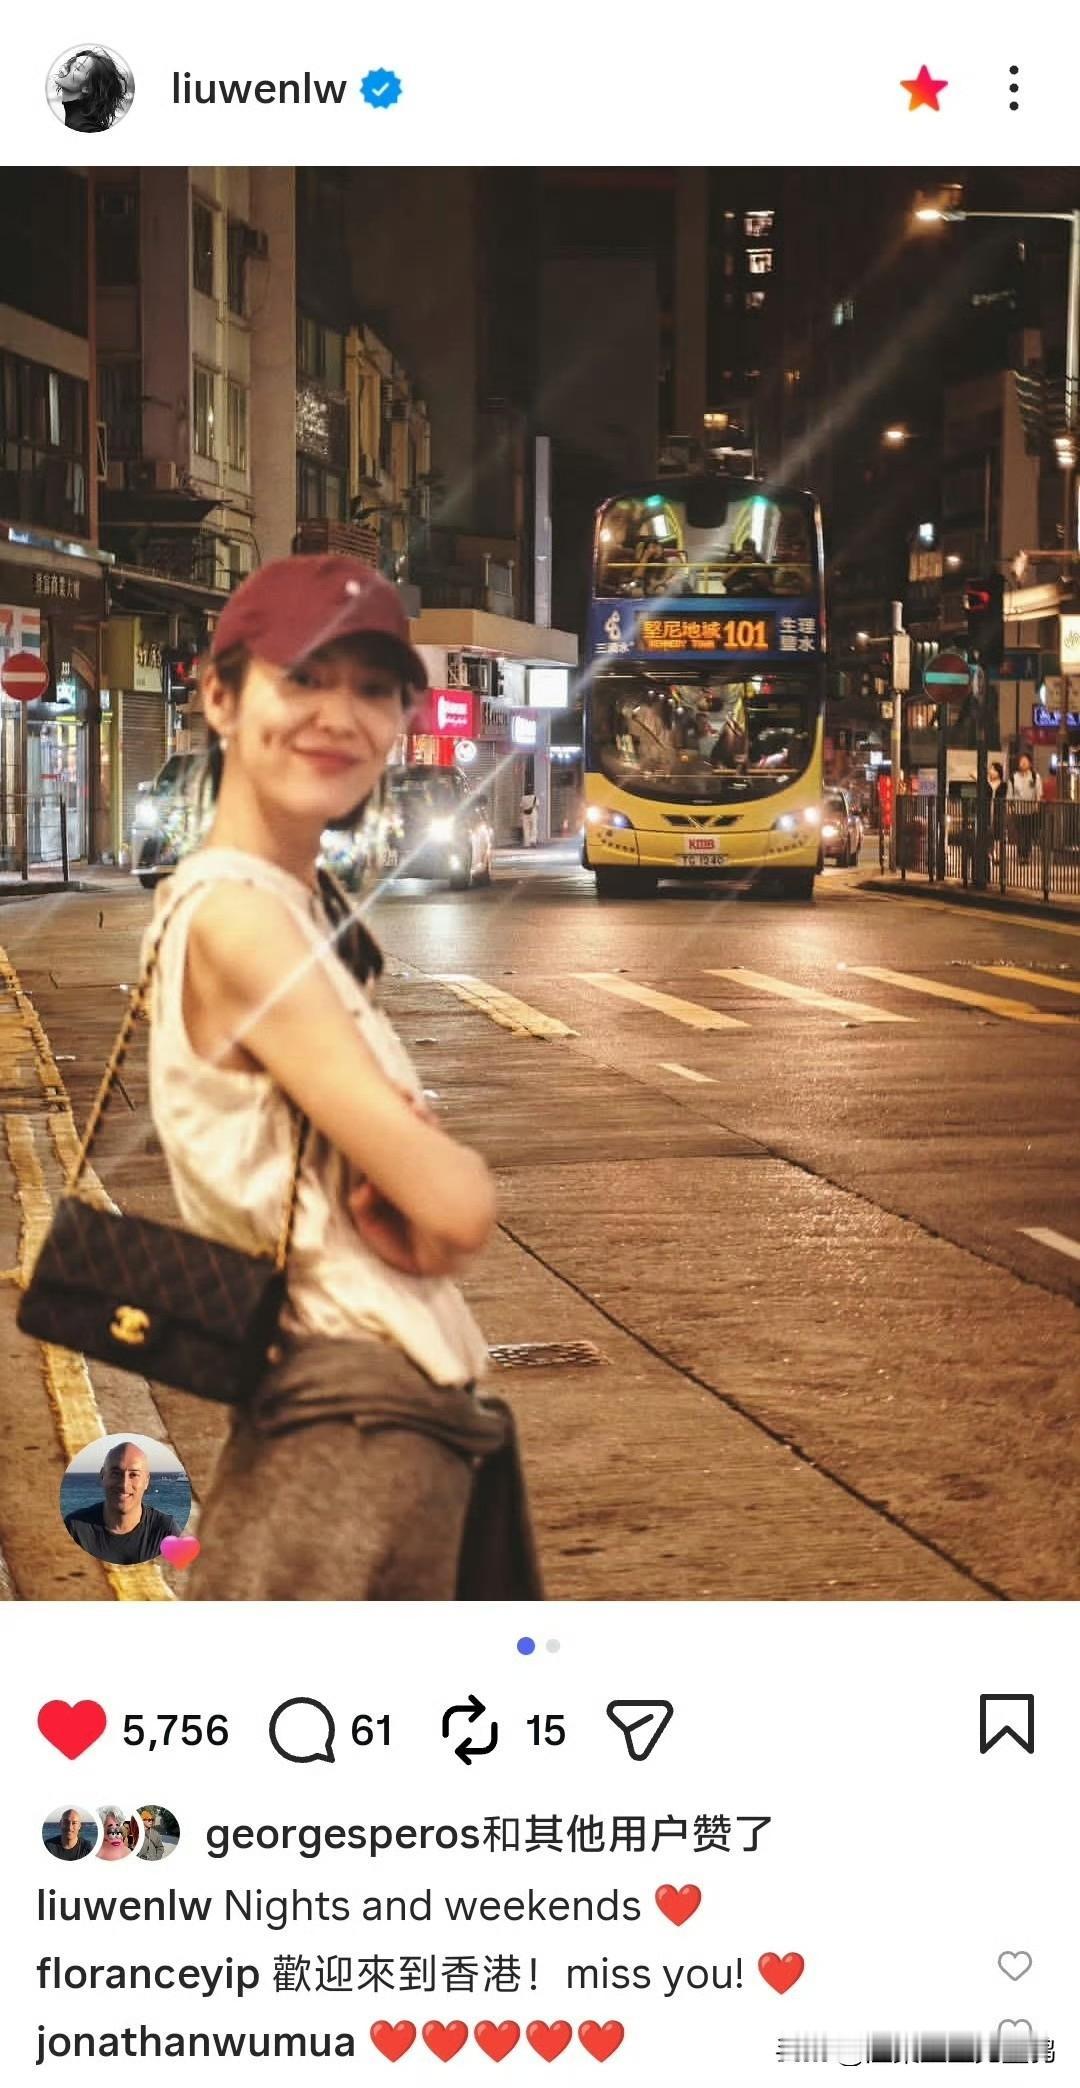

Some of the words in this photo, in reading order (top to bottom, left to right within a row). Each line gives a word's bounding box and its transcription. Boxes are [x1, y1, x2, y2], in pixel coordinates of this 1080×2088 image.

[723, 620, 768, 648] 101
[779, 617, 816, 634] 生理
[688, 838, 714, 850] KMB
